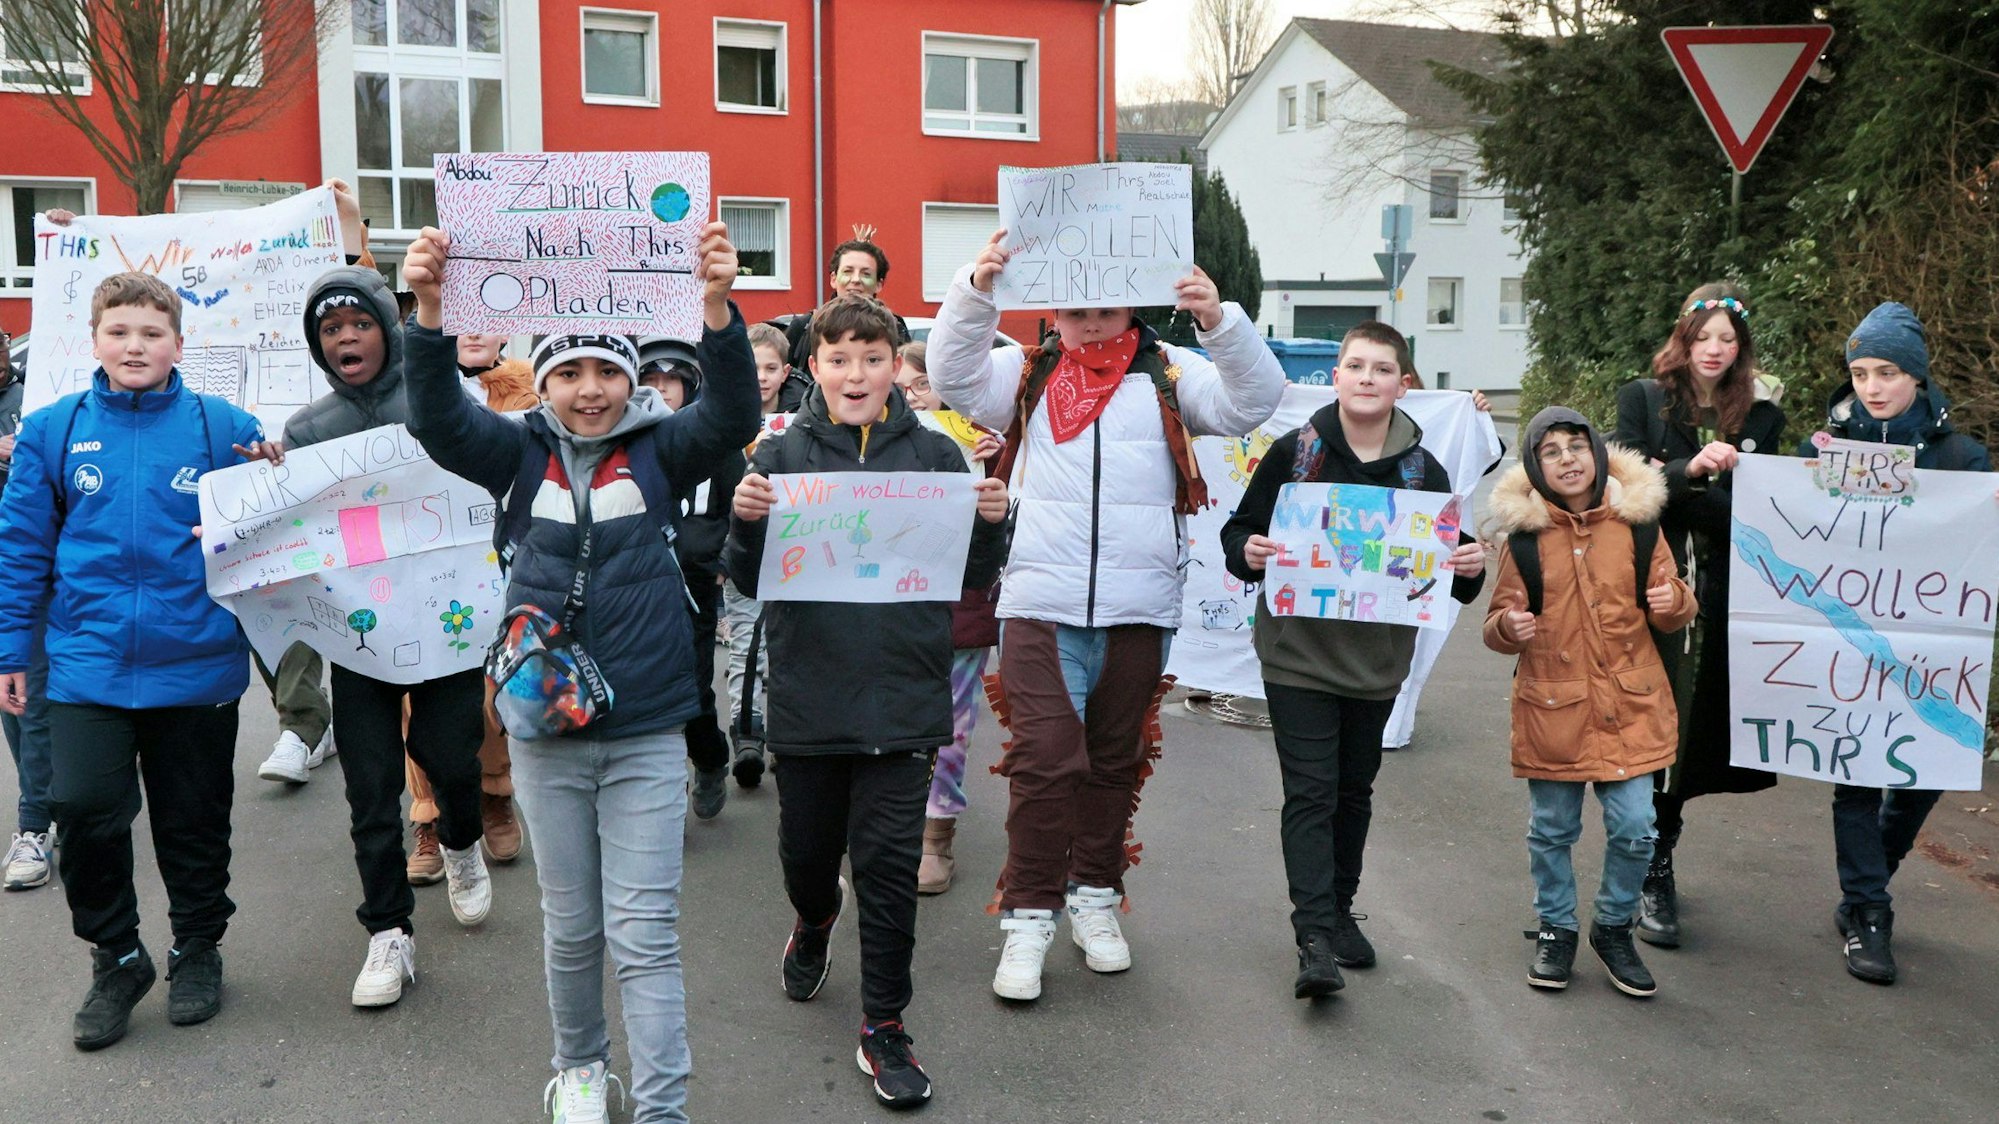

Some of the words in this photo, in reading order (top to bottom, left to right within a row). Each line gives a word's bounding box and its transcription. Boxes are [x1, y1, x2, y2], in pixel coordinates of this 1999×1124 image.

[444, 158, 493, 181] Abdou
[494, 157, 642, 211] Zurück
[1007, 173, 1079, 219] WIR
[1101, 167, 1145, 191] Thrs
[38, 232, 100, 260] THRS
[526, 226, 596, 260] Nach
[618, 225, 685, 258] Thrs
[1018, 215, 1180, 260] WOLLEN
[182, 265, 208, 288] 5B
[253, 255, 284, 275] ARDA
[1021, 259, 1142, 304] ZURÜCK
[267, 280, 305, 299] Felix
[70, 440, 102, 454] JAKO
[1821, 450, 1906, 494] THRS
[782, 476, 841, 508] Wir
[1769, 496, 1898, 551] Wir
[571, 643, 606, 703] UNDER
[1539, 932, 1556, 940] FILA
